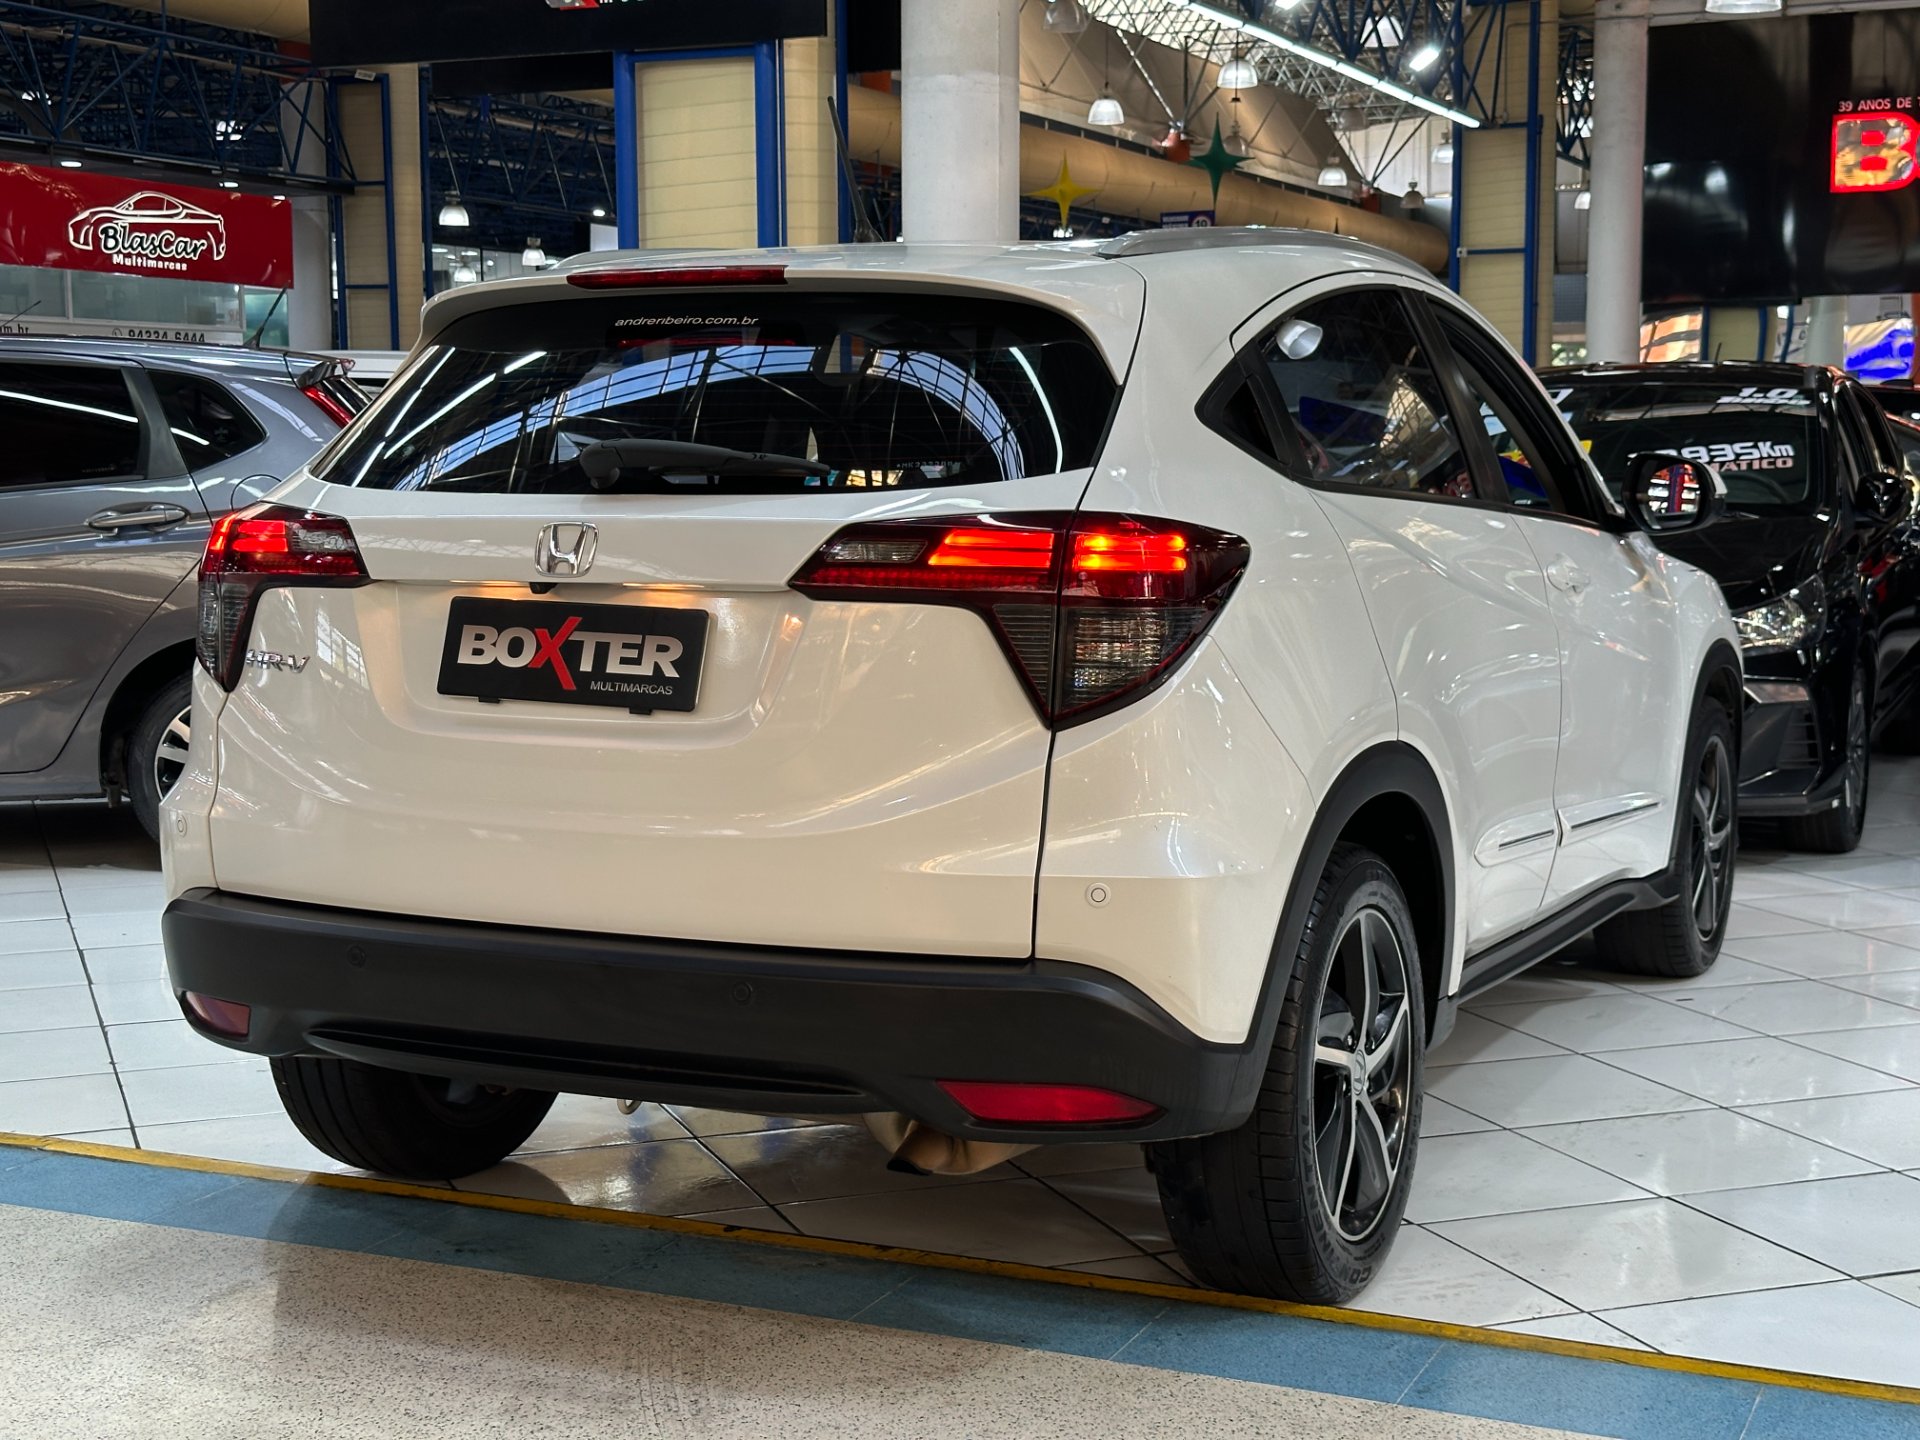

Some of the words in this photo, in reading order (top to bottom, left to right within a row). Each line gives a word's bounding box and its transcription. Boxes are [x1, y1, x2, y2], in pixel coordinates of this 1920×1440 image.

[1838, 100, 1853, 112] 39
[1857, 98, 1891, 111] ANOS
[1896, 97, 1912, 109] DE
[99, 222, 207, 260] BlasCar
[112, 254, 188, 271] Multimarcas
[614, 315, 759, 327] andreribeiro.com.br
[1738, 386, 1799, 399] 1.0
[457, 616, 684, 690] BOXTER
[245, 649, 311, 674] HR-V
[590, 680, 673, 695] MULTIMARCAS
